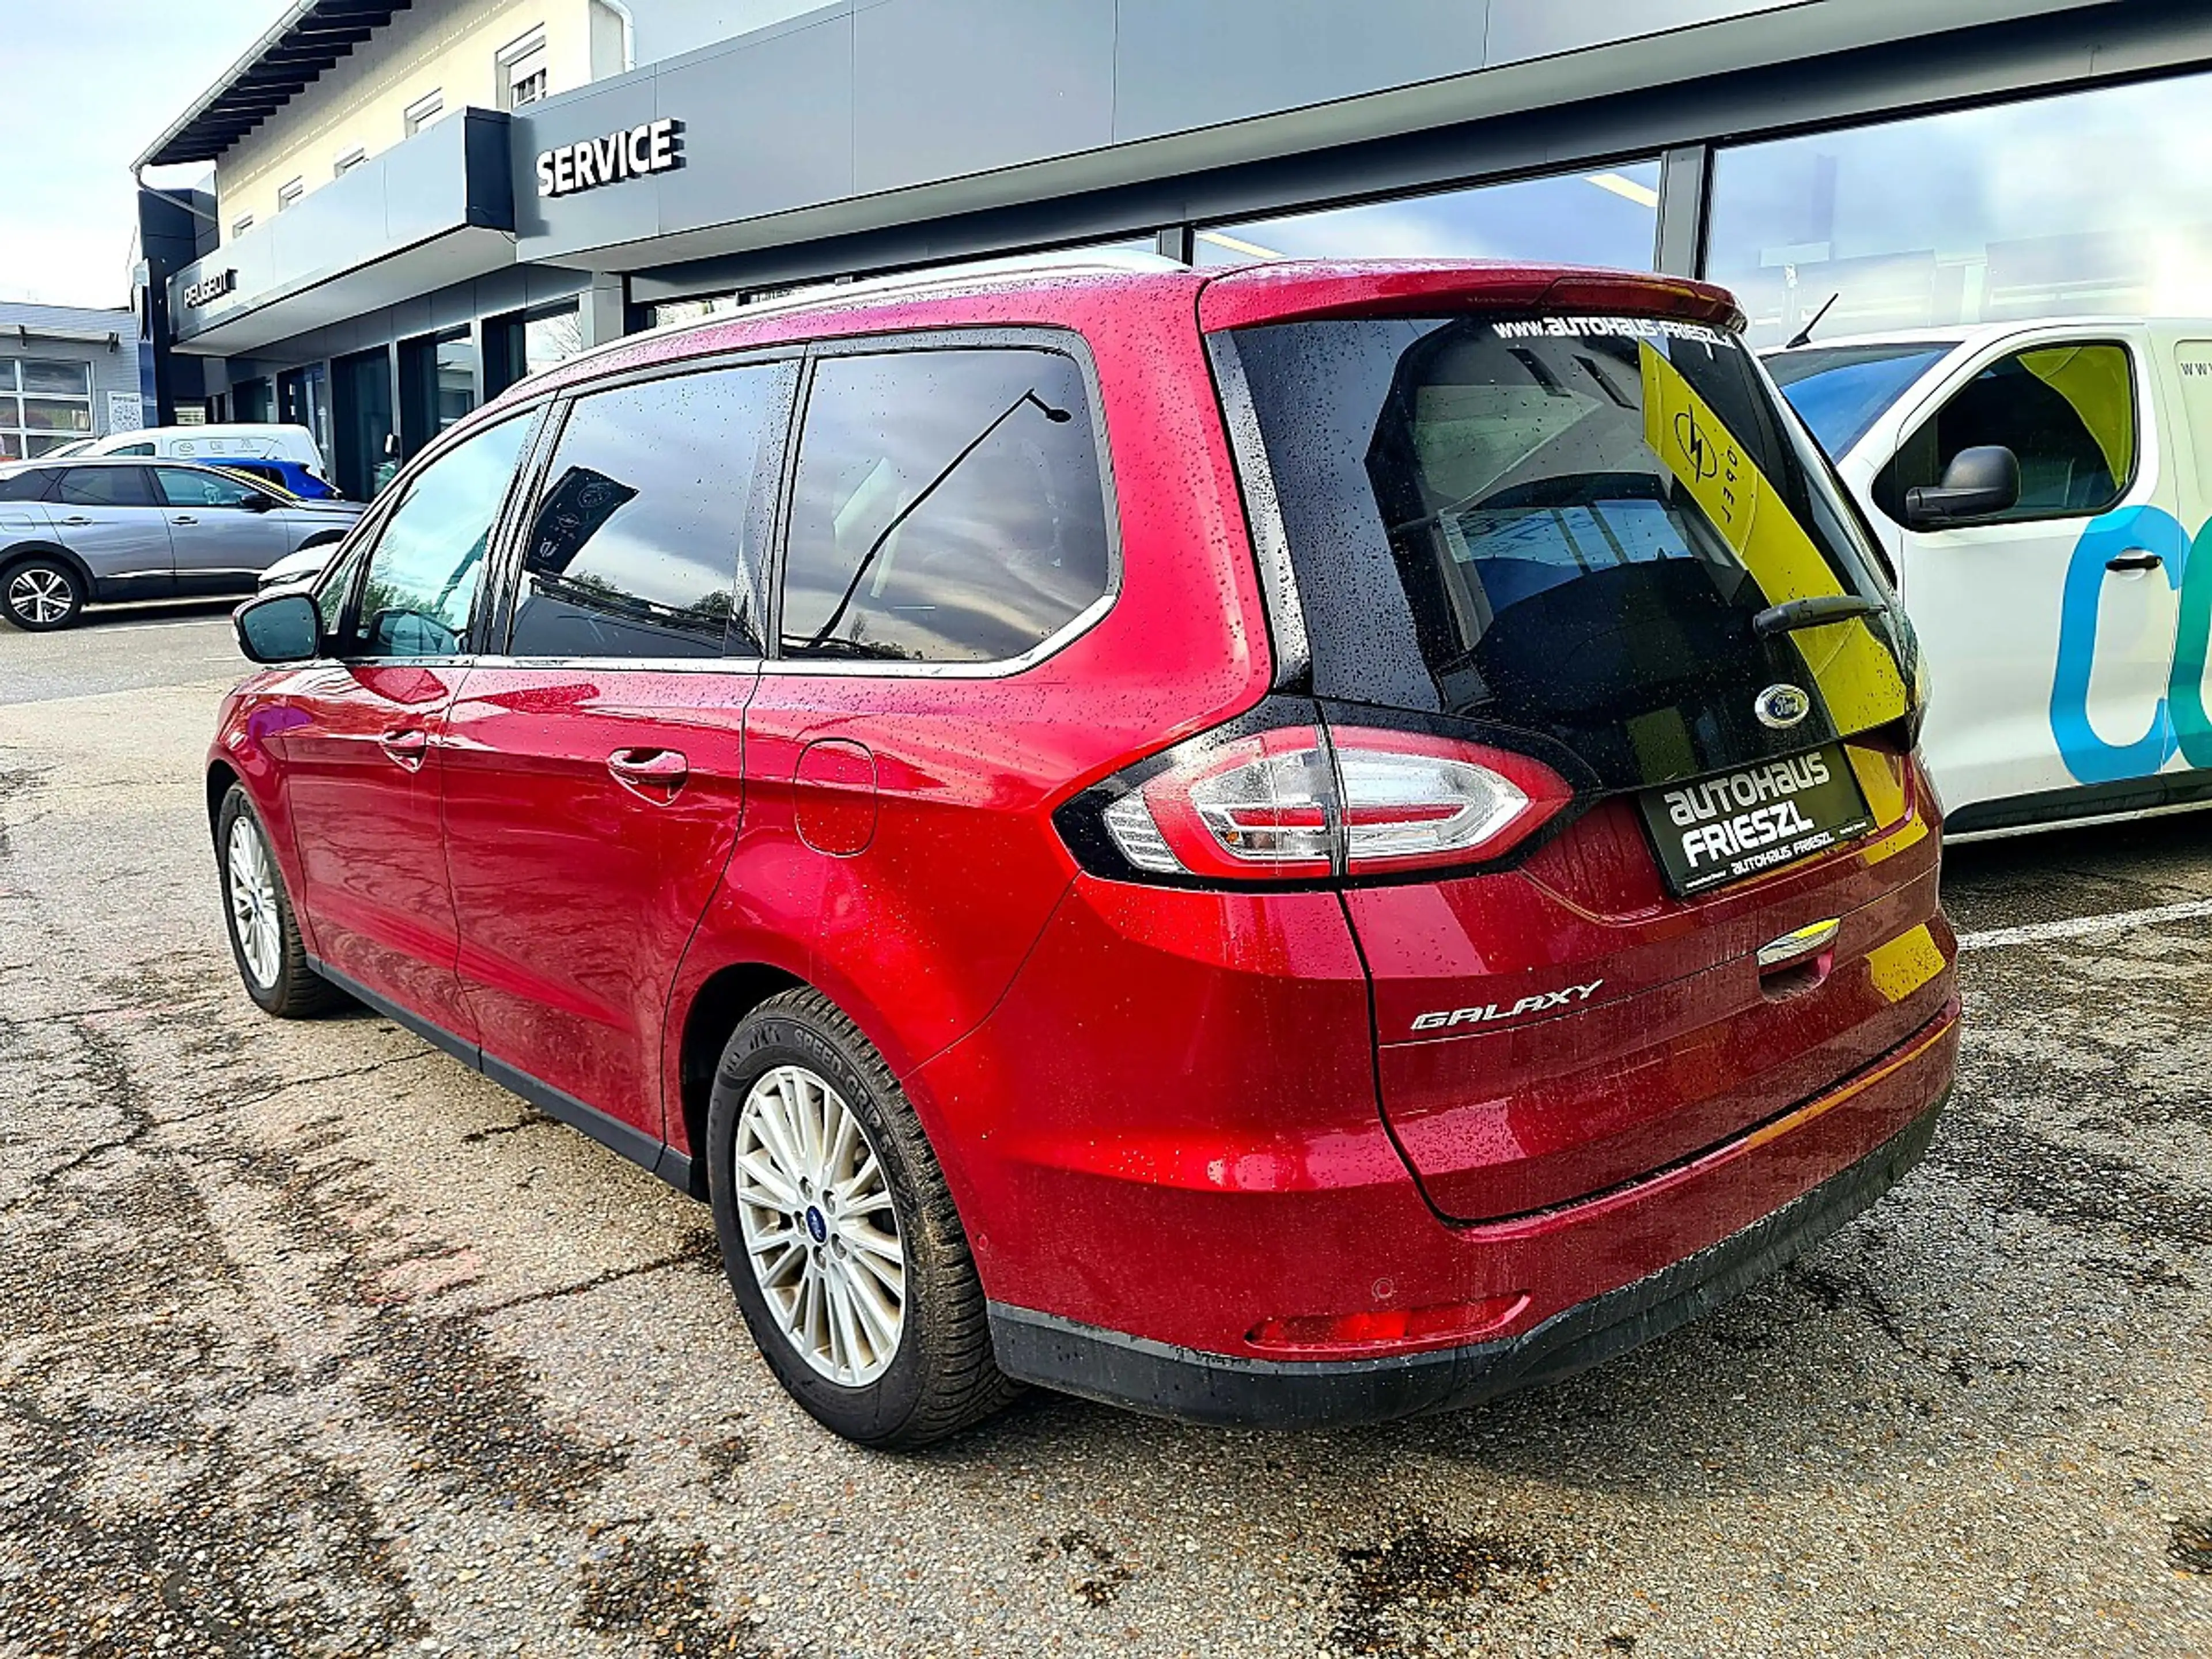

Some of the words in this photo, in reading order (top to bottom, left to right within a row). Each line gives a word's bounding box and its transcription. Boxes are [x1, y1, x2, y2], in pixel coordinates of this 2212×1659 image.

[536, 118, 686, 196] SERVICE
[184, 269, 238, 309] PEUGEOT
[1682, 800, 1815, 867] FRIESZL
[1793, 831, 1835, 855] FRIESZL
[1410, 979, 1603, 1030] GALAXY
